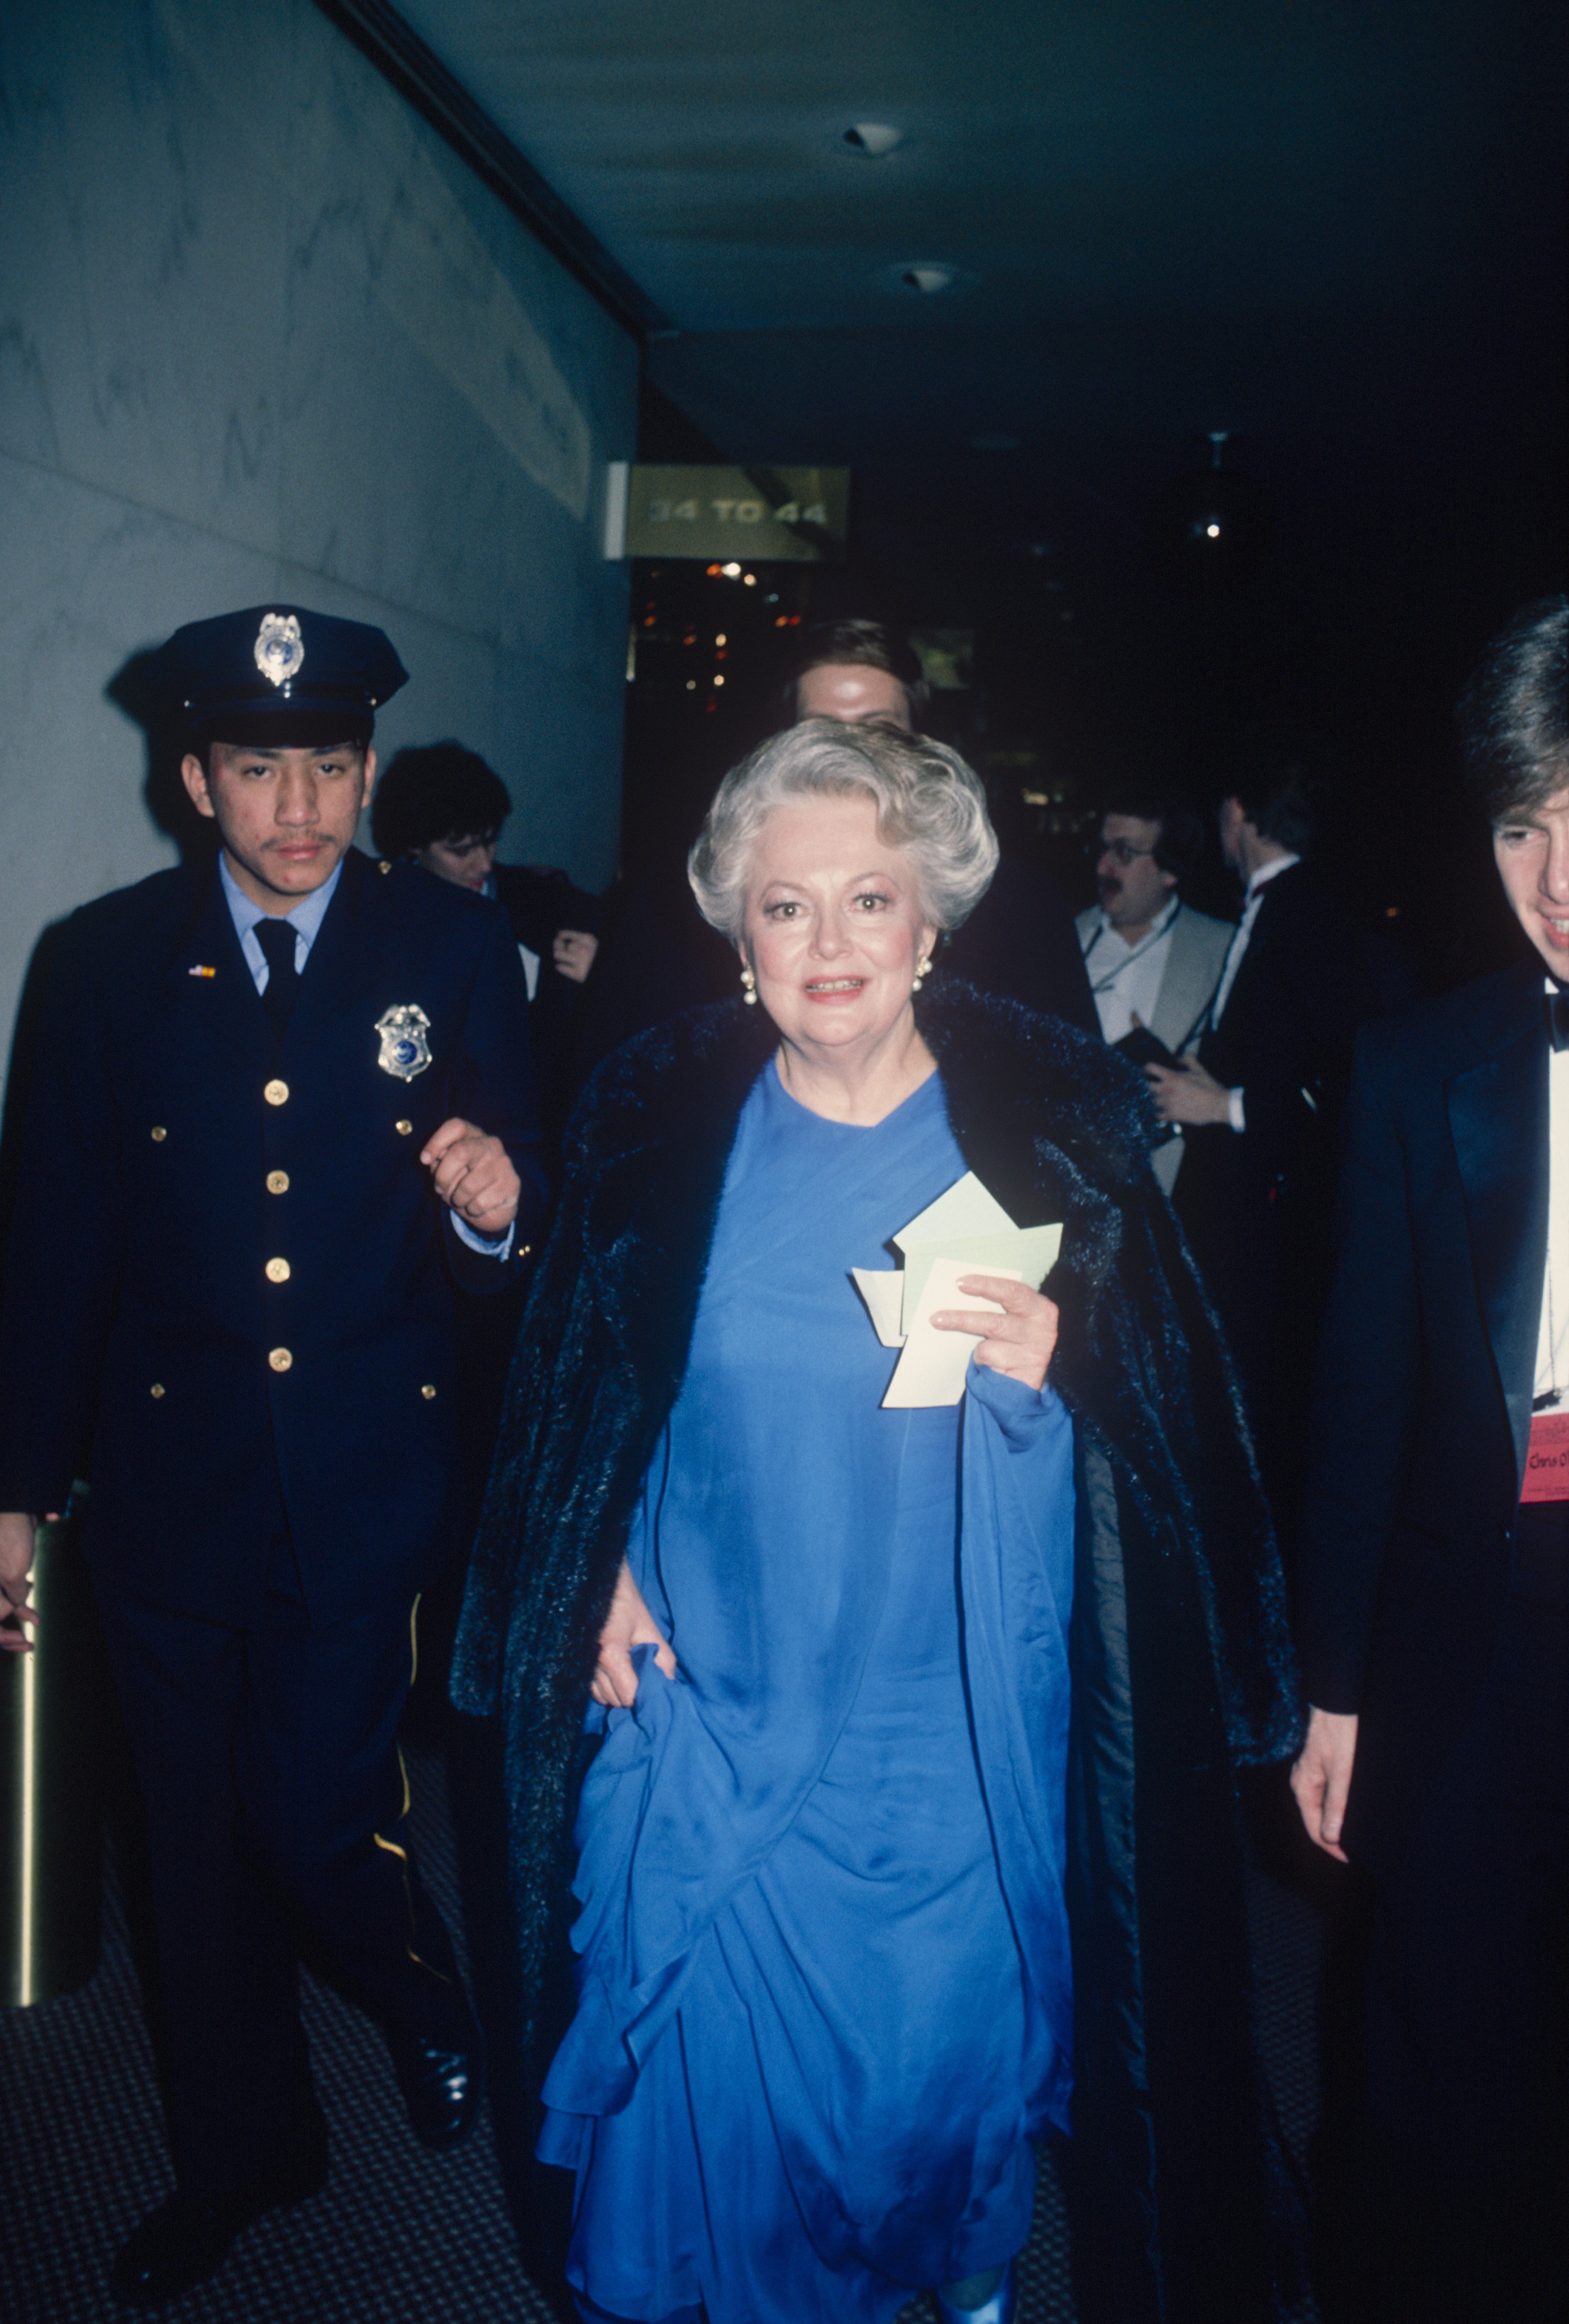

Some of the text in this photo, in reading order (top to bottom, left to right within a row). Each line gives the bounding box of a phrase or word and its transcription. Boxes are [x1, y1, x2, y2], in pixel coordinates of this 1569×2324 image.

[649, 498, 827, 525] 34 TO 44
